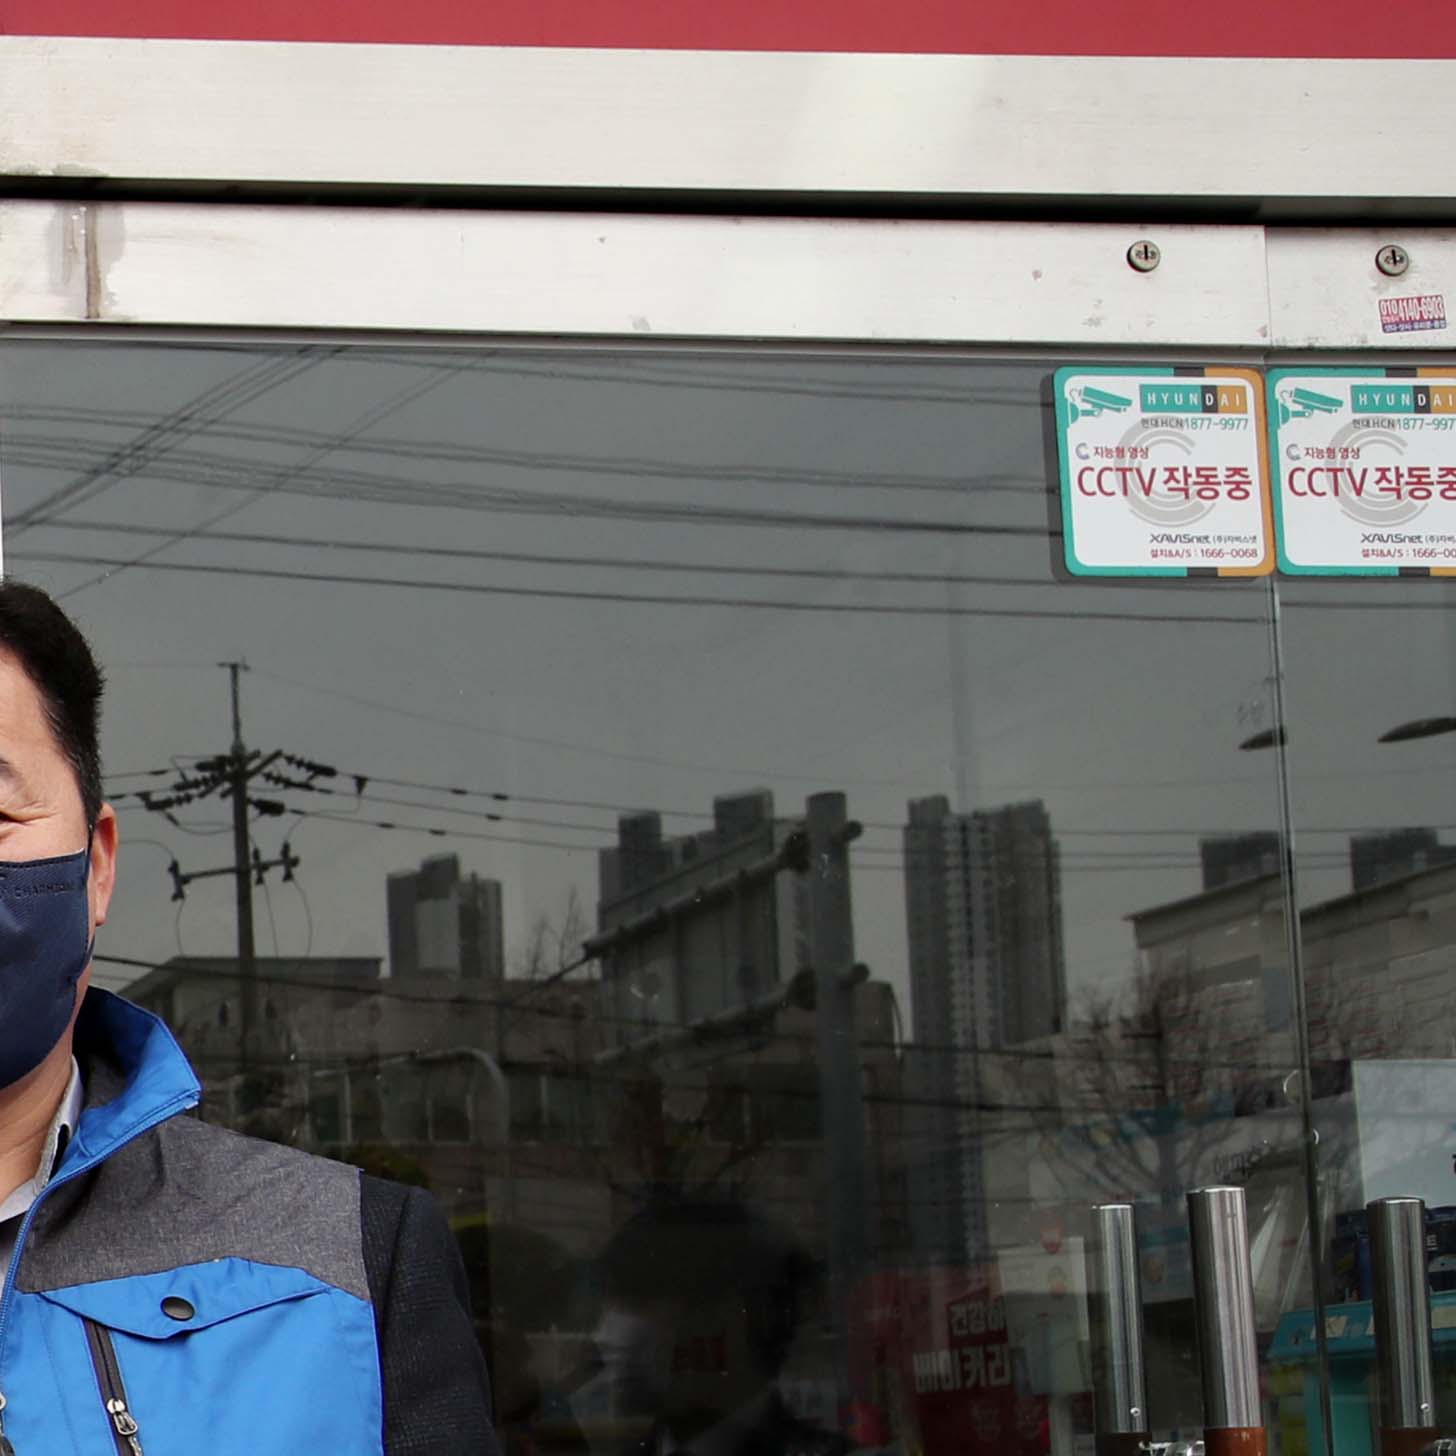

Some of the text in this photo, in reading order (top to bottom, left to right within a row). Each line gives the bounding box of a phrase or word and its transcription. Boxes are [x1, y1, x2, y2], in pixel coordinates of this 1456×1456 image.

[1148, 392, 1240, 405] HYUNDAI
[1358, 393, 1453, 406] HYUNDAI
[1185, 418, 1248, 430] 1877-9977
[1128, 446, 1149, 459] 영상
[1339, 447, 1360, 459] 영상
[1077, 466, 1252, 501] CCTV 작동중
[1289, 466, 1456, 501] CCTV 작동중
[1201, 549, 1257, 559] 1666-0068
